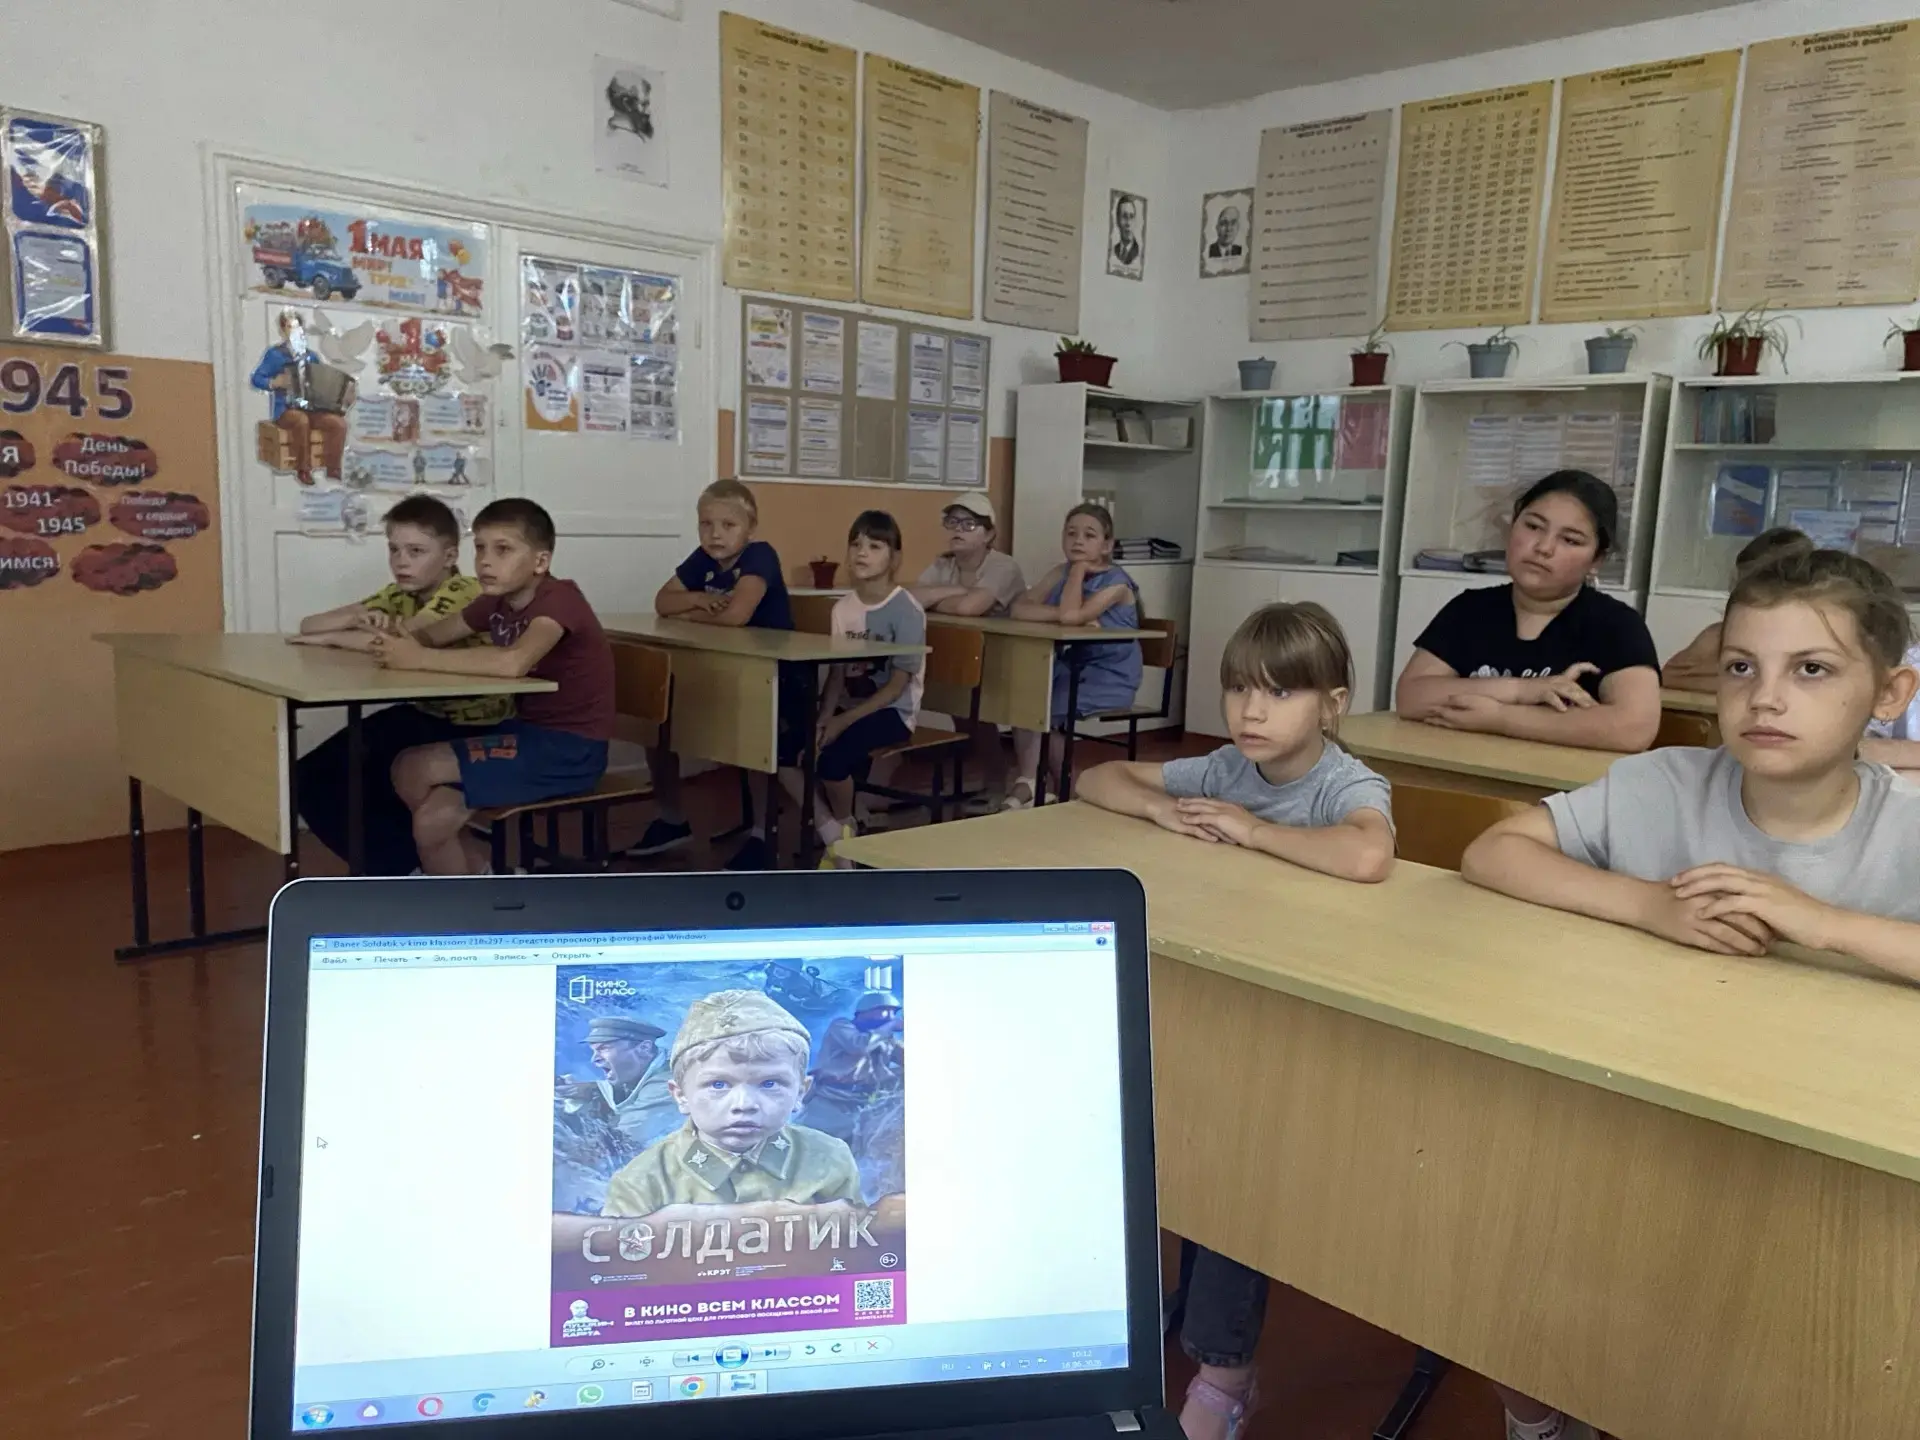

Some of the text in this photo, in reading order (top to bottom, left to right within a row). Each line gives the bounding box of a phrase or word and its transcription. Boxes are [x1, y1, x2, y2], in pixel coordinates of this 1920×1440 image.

[347, 219, 425, 260] 1 МАЯ
[80, 437, 129, 455] День
[64, 460, 146, 478] Победы!
[4, 492, 61, 508] 1941-
[37, 516, 86, 534] 1945
[362, 939, 397, 948] Soldatik
[408, 938, 428, 947] kino
[430, 938, 467, 947] klassom
[512, 937, 554, 946] Средство
[557, 936, 607, 945] просмотра
[610, 934, 666, 943] фотографий
[667, 932, 707, 941] Windows
[322, 956, 347, 965] Файл
[374, 955, 408, 963] Печать
[494, 953, 527, 961] Запись
[552, 952, 592, 960] Открыть
[596, 980, 628, 989] КИНО
[596, 988, 637, 996] КЛАСС
[882, 1255, 896, 1264] 6+
[707, 1268, 731, 1277] КРЭТ
[624, 1293, 840, 1318] В КИНО ВСЕМ КЛАССОМ
[942, 1363, 954, 1372] RU
